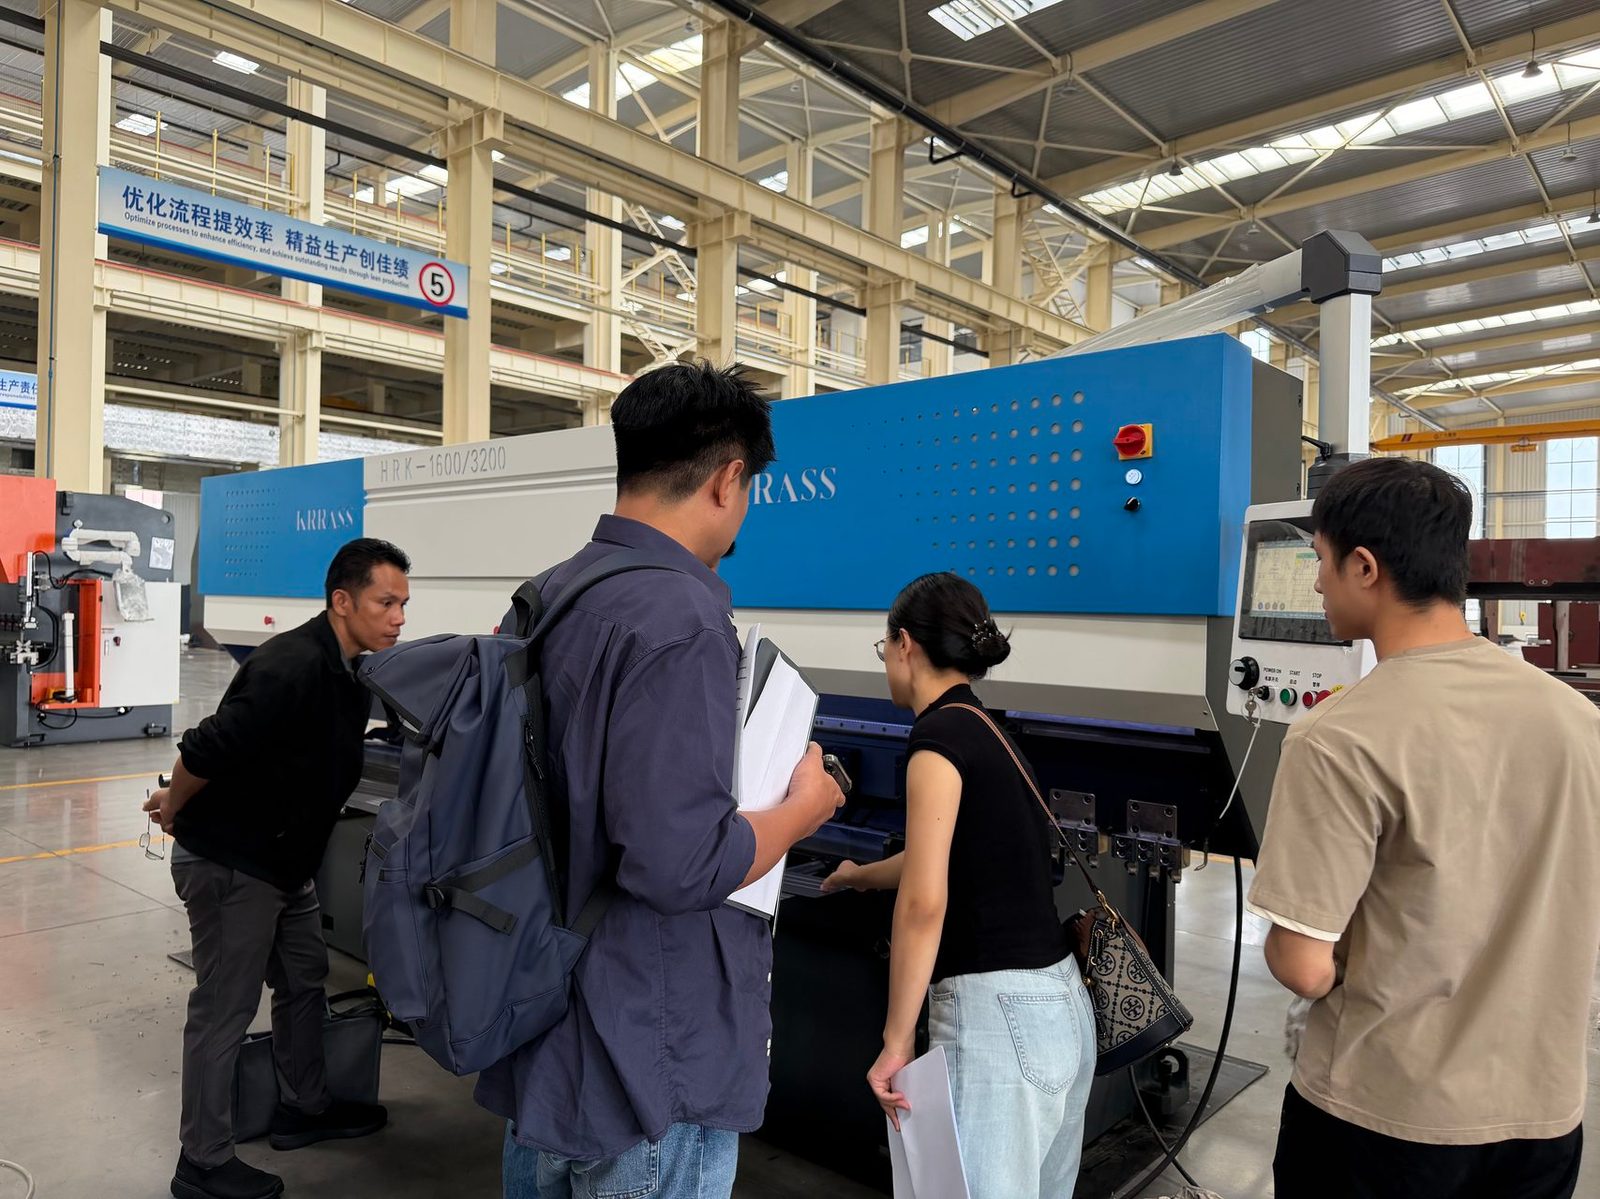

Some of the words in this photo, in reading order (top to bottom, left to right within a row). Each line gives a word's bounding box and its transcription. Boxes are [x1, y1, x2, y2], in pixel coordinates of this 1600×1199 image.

[122, 184, 274, 244] 优化流程提效率
[285, 228, 409, 280] 精益生产创佳绩
[124, 211, 156, 226] Optimize
[157, 221, 190, 236] processes
[191, 229, 199, 237] to
[200, 231, 226, 244] enhance
[227, 237, 259, 253] efficiency,
[260, 246, 271, 255] and
[431, 272, 445, 297] 5
[380, 446, 506, 482] HRK-1600/3200
[748, 466, 837, 505] RASS
[296, 508, 354, 532] KRRASS
